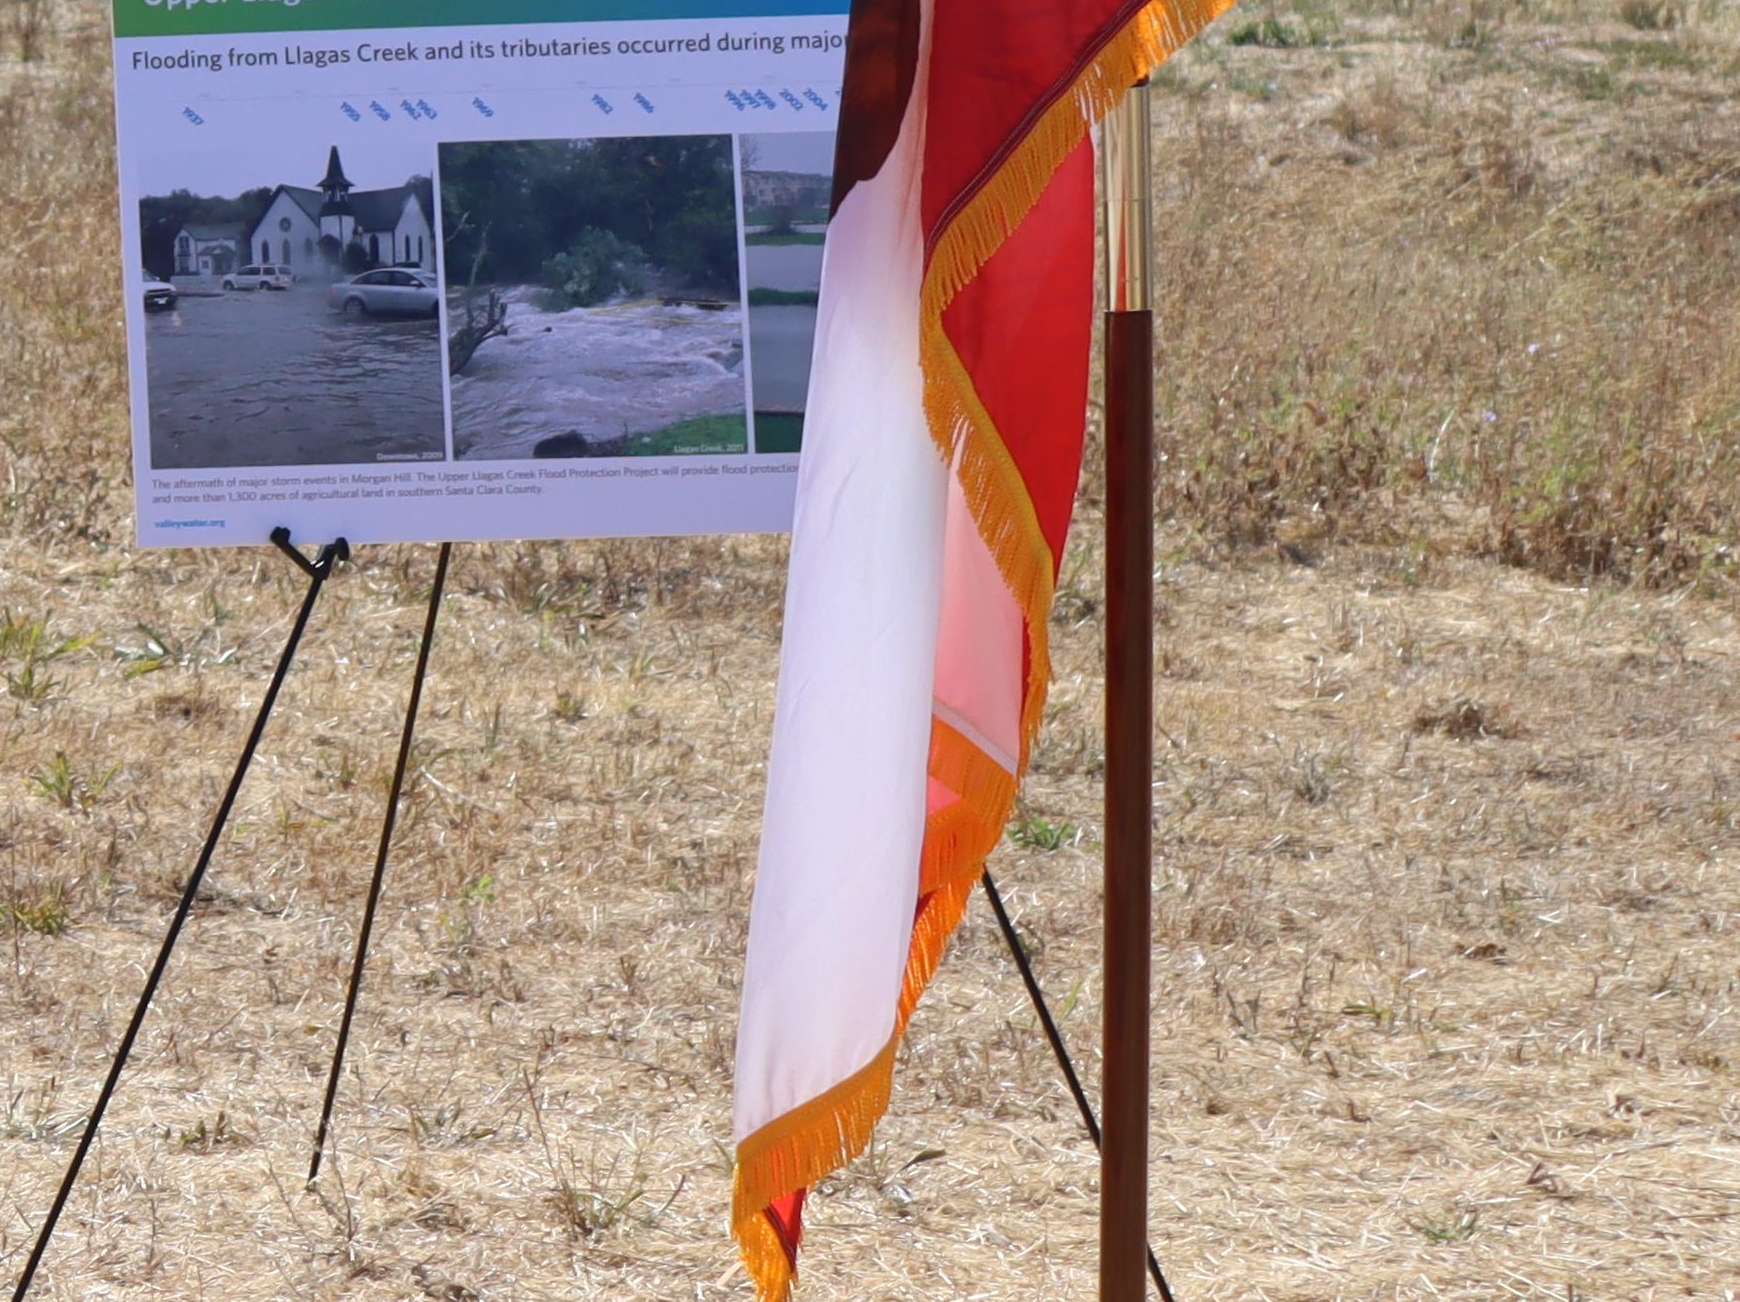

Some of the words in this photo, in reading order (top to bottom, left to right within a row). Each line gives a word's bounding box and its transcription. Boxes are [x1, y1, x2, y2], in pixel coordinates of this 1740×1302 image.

[132, 50, 222, 72] Flooding
[228, 47, 278, 68] from
[284, 45, 351, 69] Llagas
[357, 42, 419, 63] Creek
[425, 40, 464, 60] and
[470, 40, 495, 59] its
[501, 37, 611, 59] tributaries
[617, 32, 711, 54] occurred
[716, 30, 784, 54] during
[182, 106, 205, 126] 1937
[472, 97, 494, 118] 1969
[591, 93, 614, 115] 1982
[779, 87, 804, 110] 2002
[802, 86, 828, 111] 2004
[152, 479, 171, 489] The
[173, 478, 224, 489] aftermath
[226, 477, 236, 487] of
[239, 477, 268, 490] major
[271, 477, 300, 486] storm
[303, 476, 337, 485] events
[339, 474, 349, 484] in
[351, 473, 392, 485] Morgan
[416, 472, 436, 482] The
[438, 472, 469, 483] Upper
[472, 470, 504, 482] Llagas
[506, 469, 535, 480] Creek
[538, 468, 567, 479] Flood
[569, 467, 621, 478] Protection
[623, 466, 659, 479] Project
[662, 466, 679, 476] will
[681, 465, 719, 477] provide
[721, 464, 748, 475] flood
[152, 493, 171, 504] and
[173, 494, 200, 503] more
[202, 493, 226, 502] than
[227, 491, 258, 502] 1,300
[259, 492, 286, 501] acres
[288, 490, 299, 500] of
[302, 488, 359, 502] agricultural
[361, 488, 383, 498] land
[385, 487, 396, 497] in
[397, 486, 442, 497] southern
[444, 486, 474, 496] Santa
[476, 484, 503, 495] Clara
[154, 519, 226, 530] valleywater.org
